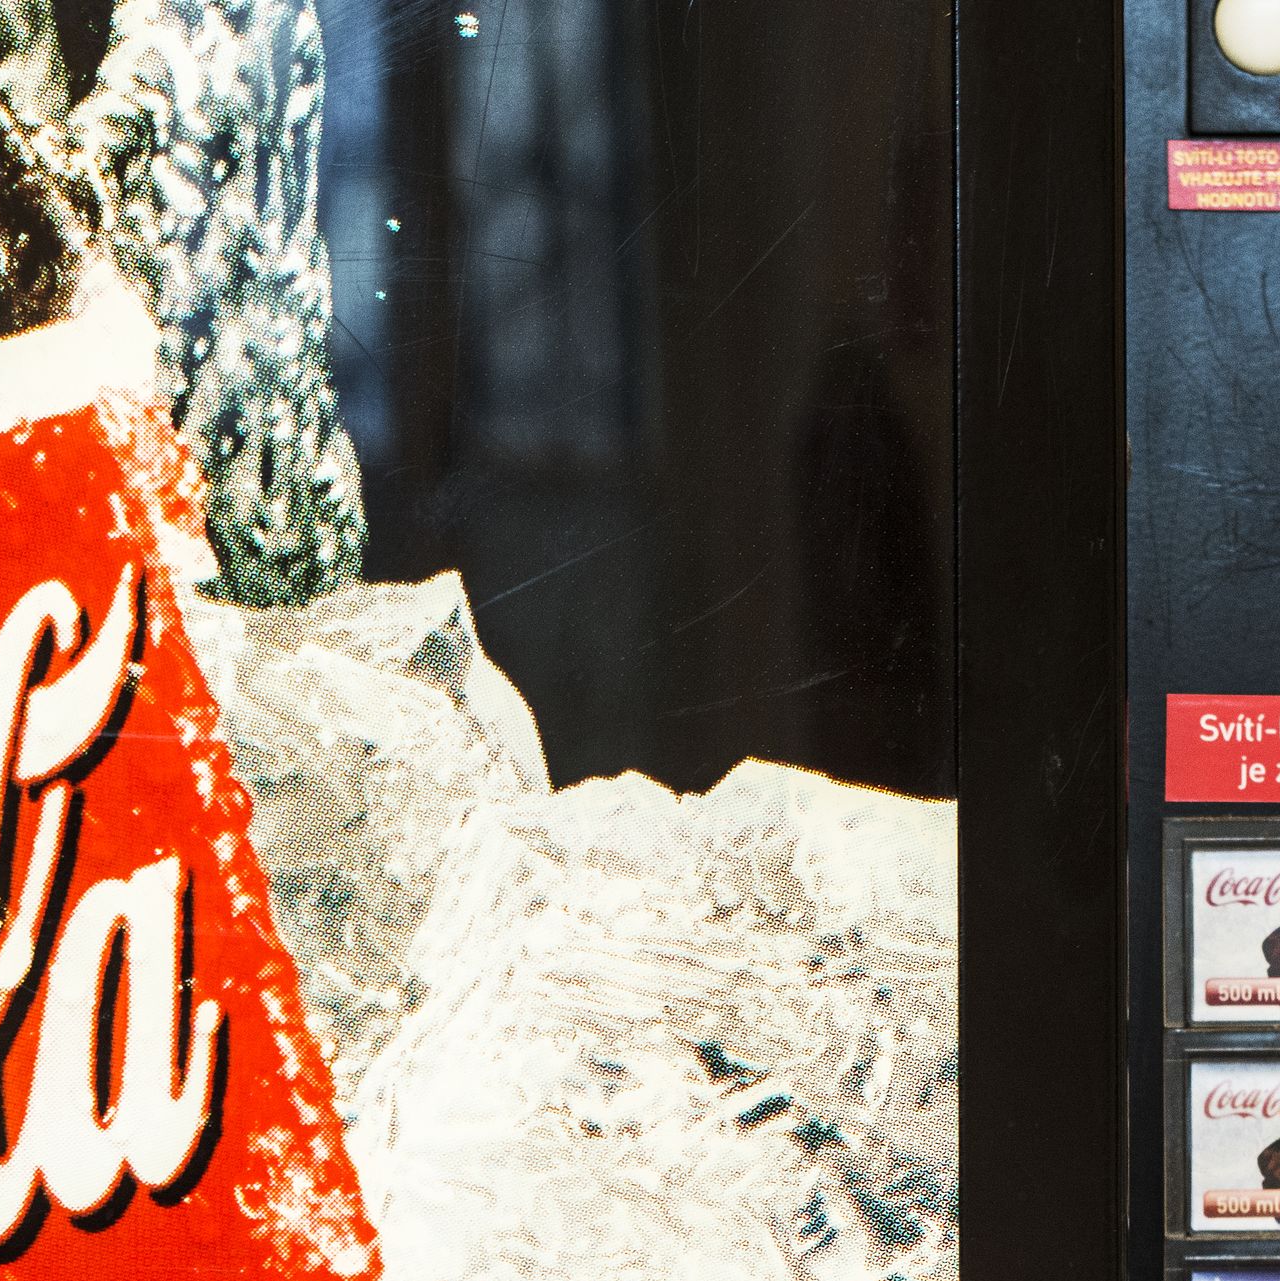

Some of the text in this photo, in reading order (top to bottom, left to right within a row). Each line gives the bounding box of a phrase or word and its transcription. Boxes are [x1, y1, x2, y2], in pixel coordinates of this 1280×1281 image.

[1235, 149, 1278, 165] TOTO
[1178, 170, 1262, 187] VHAZUJTE
[1196, 191, 1274, 208] HODNOTU
[1238, 757, 1267, 790] je
[1218, 984, 1253, 1003] 500
[1216, 1195, 1280, 1215] 500 ml
